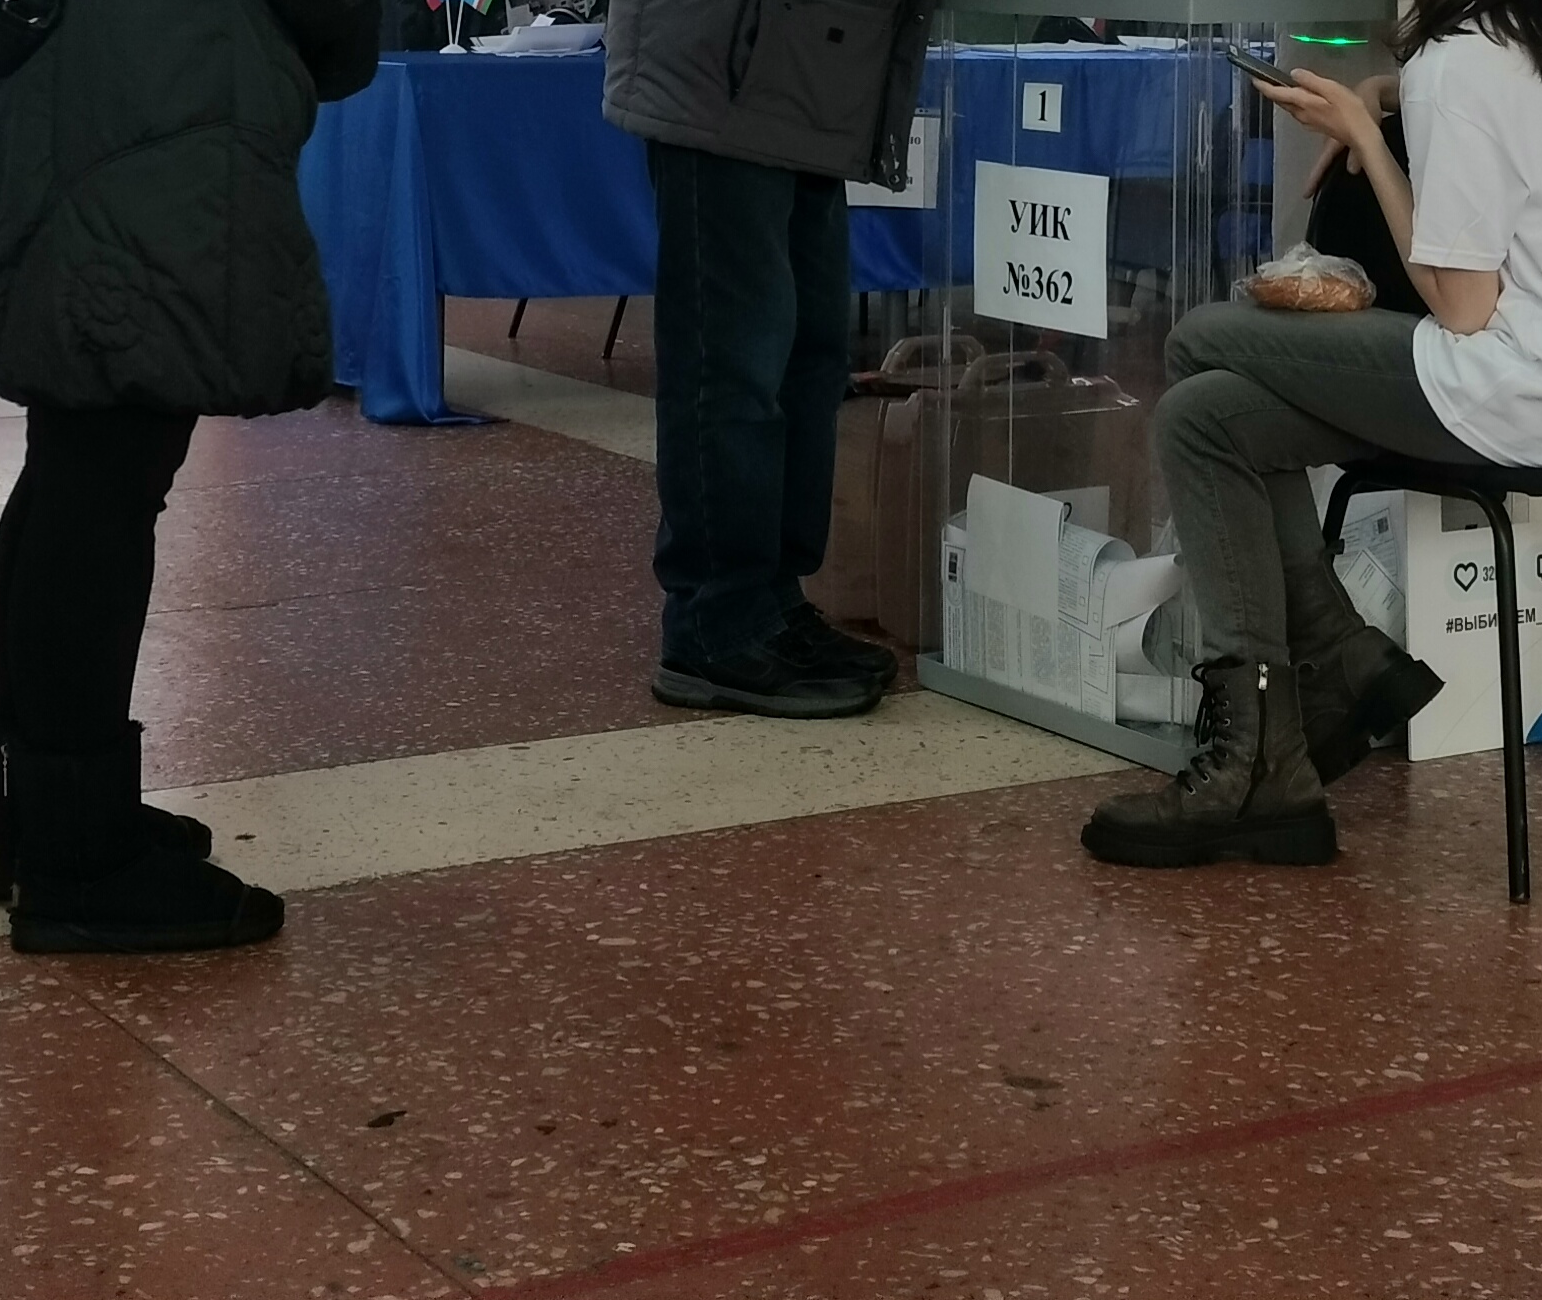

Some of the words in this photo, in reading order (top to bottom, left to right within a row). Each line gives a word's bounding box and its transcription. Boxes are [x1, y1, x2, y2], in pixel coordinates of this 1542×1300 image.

[1037, 90, 1048, 122] 1
[1008, 200, 1072, 242] УИК
[1003, 261, 1074, 305] №362
